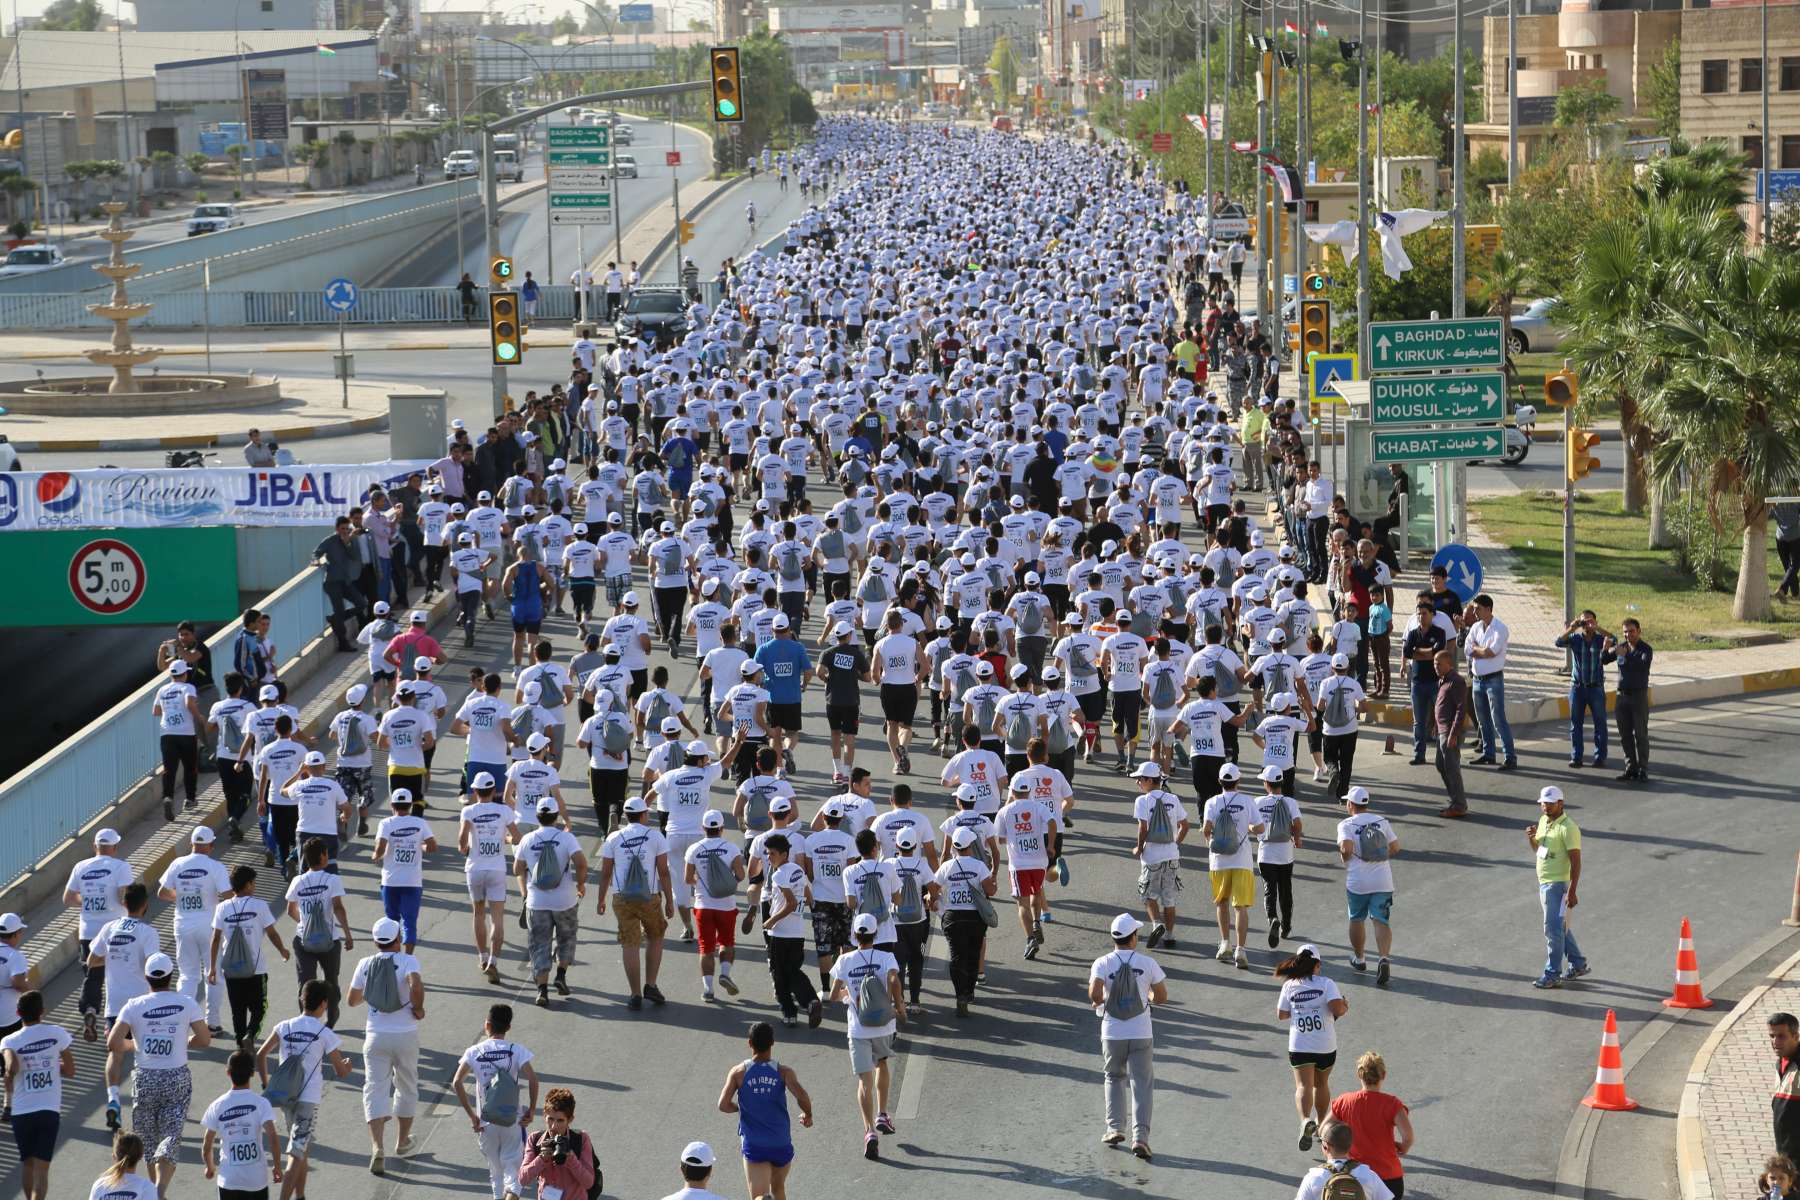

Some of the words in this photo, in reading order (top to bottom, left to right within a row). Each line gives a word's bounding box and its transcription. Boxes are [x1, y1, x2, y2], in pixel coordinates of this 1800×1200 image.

[501, 262, 510, 276] 6
[1314, 277, 1323, 290] 6
[1395, 328, 1466, 343] BAGHDAD
[1395, 348, 1445, 362] KIRKUK
[1376, 383, 1436, 398] DUHOK
[1377, 403, 1443, 418] MOUSUL
[1378, 439, 1439, 454] KHABAT
[38, 513, 83, 528] pepsi
[699, 619, 714, 629] 1802
[834, 655, 853, 668] 2026
[1118, 662, 1135, 673] 2182
[775, 664, 792, 674] 2029
[166, 713, 185, 727] 1361
[475, 715, 493, 728] 2031
[392, 733, 412, 745] 1574
[1196, 738, 1214, 750] 894
[1270, 745, 1287, 756] 1662
[679, 792, 699, 804] 3412
[479, 842, 500, 855] 3004
[1018, 838, 1039, 852] 1948
[394, 849, 417, 863] 3287
[820, 863, 841, 876] 1580
[84, 897, 107, 911] 2152
[181, 896, 202, 910] 1999
[951, 890, 973, 904] 3265
[146, 1006, 181, 1016] SAMSUNG
[1297, 1015, 1323, 1033] 996
[144, 1038, 172, 1055] 3260
[25, 1071, 53, 1089] 1684
[230, 1143, 258, 1161] 1603
